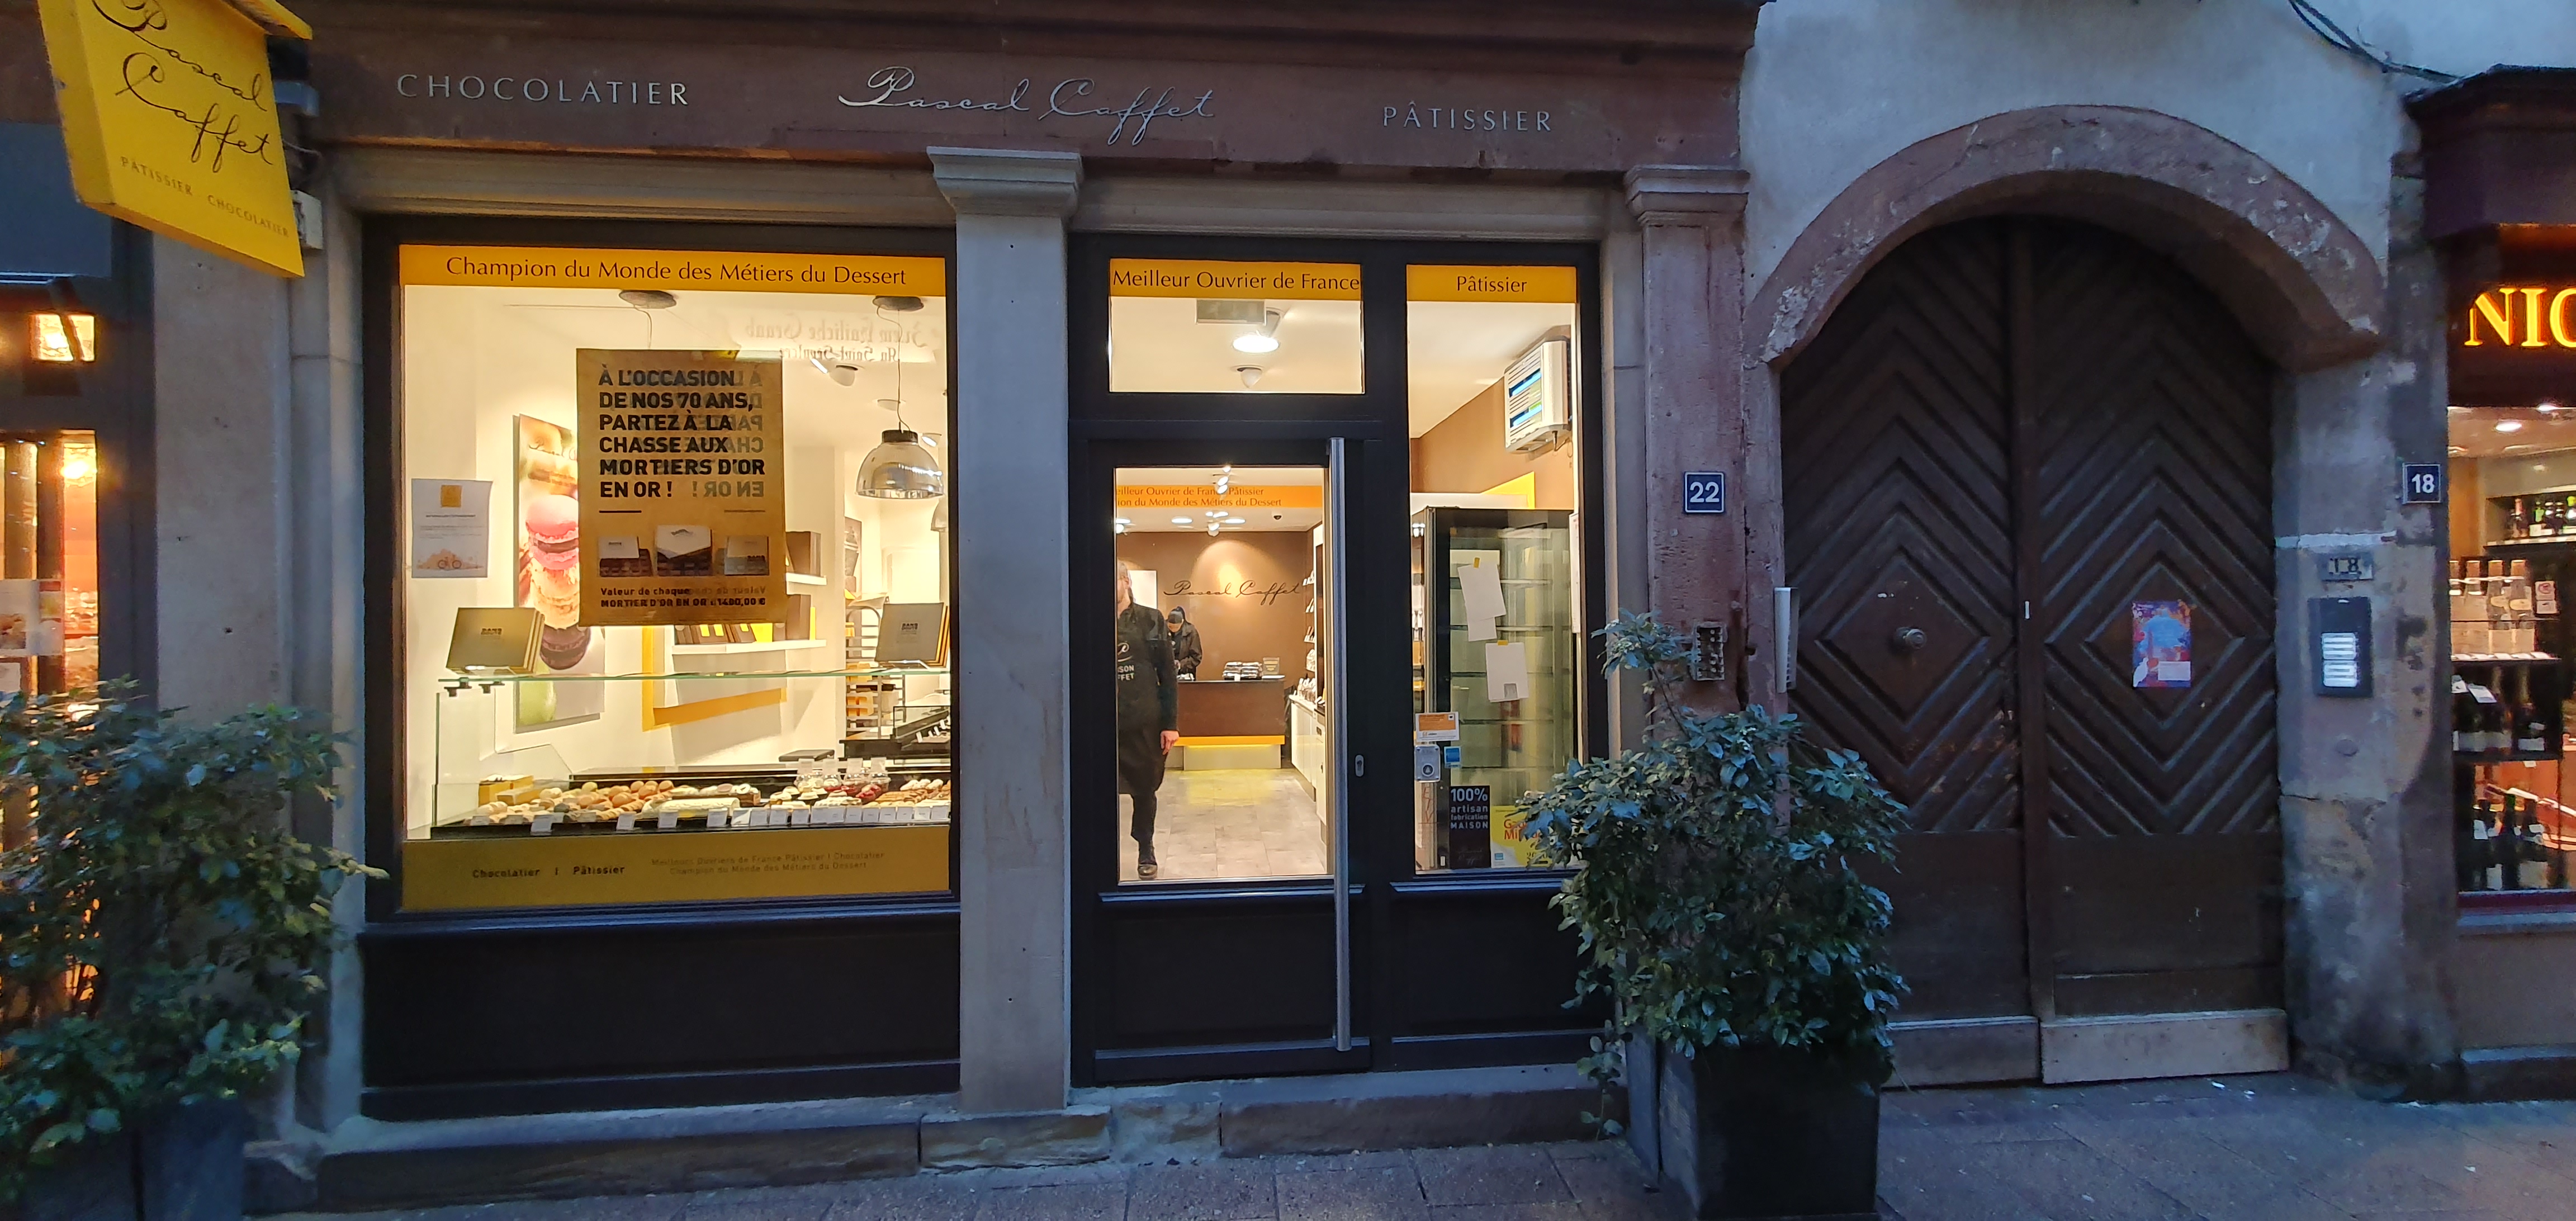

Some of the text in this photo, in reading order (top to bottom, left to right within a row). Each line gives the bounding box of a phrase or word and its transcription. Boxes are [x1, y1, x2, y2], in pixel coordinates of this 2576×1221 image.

[396, 74, 689, 106] CHOCOLATIER
[115, 52, 273, 173] Caffet
[838, 65, 1215, 146] Pascal Caffet
[1382, 100, 1551, 132] PÂTISSIER
[207, 194, 290, 238] CHOCOLATIER
[446, 256, 907, 285] Champion du Monde des Métiers du Dessert
[1113, 269, 1361, 291] Meilleur Ouvrier de France
[1456, 275, 1528, 293] Pâtissier
[598, 363, 613, 387] À
[618, 370, 735, 387] L'OCCASION
[599, 391, 627, 409] DE
[632, 391, 674, 409] NOS
[677, 391, 702, 409] 70
[706, 391, 754, 412] ANS,
[599, 414, 680, 431] PARTEZ
[683, 409, 698, 431] À
[706, 414, 733, 431] LA
[599, 436, 681, 453] CHASSE
[685, 436, 729, 453] AUX
[599, 458, 766, 475] MORTIERS D'OR
[600, 481, 673, 498] EN OR !
[1116, 486, 1264, 495] eilleur Ouvrier de Fran Pâtissier
[1689, 481, 1721, 503] 22
[2411, 473, 2435, 494] 18
[1134, 497, 1146, 507] du
[1149, 497, 1181, 507] Monde
[1183, 497, 1198, 507] des
[1200, 498, 1233, 507] Métiers
[1235, 497, 1247, 507] du
[1250, 498, 1282, 507] Dessert
[600, 587, 690, 597] Valeur de chaque
[1163, 579, 1301, 606] Pascal Caffet
[1450, 788, 1488, 802] 100%
[1450, 821, 1489, 830] MAISON
[472, 868, 541, 878] Chocolatier
[573, 865, 625, 875] Pâtissier
